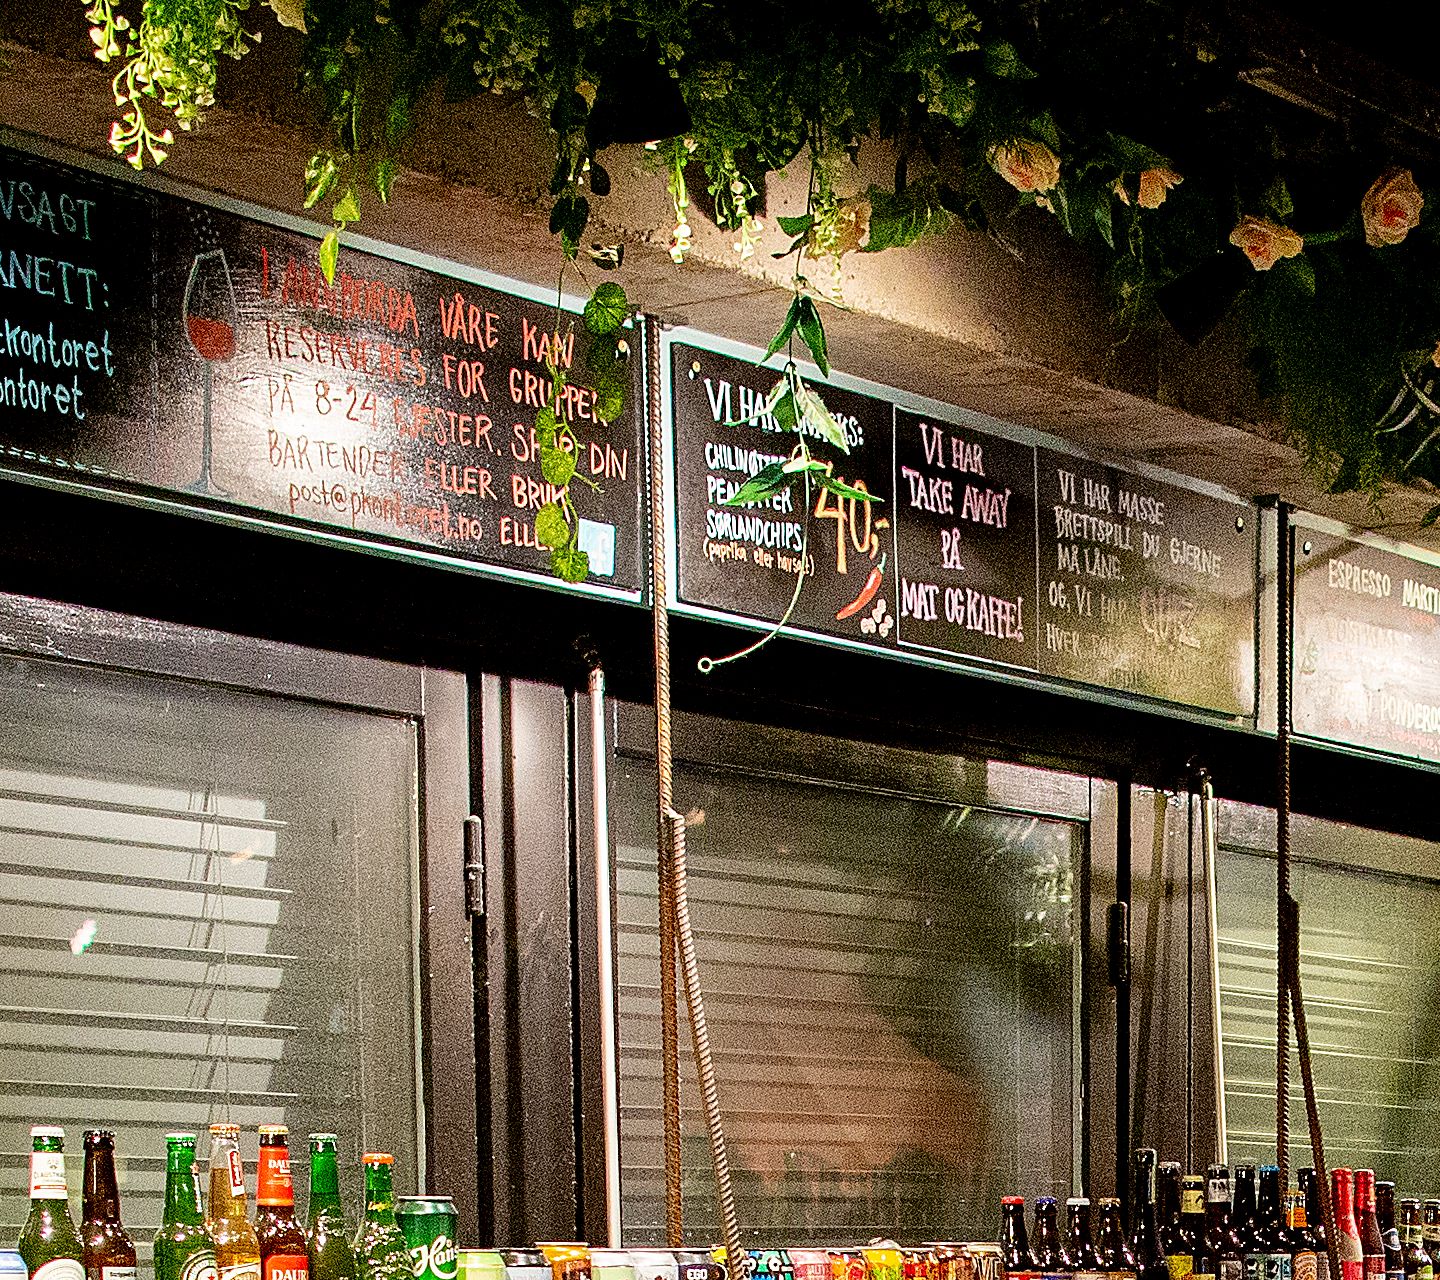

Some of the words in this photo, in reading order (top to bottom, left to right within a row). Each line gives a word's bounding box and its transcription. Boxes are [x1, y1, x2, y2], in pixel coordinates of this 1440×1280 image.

[439, 292, 500, 352] VÅRE
[266, 375, 295, 417] PÅ
[315, 380, 378, 428] 8-24
[920, 423, 943, 466] VI
[951, 436, 984, 471] HAR
[425, 457, 497, 500] ELLER
[901, 466, 953, 515] TAKE
[961, 485, 1012, 529] AWAY
[1059, 469, 1076, 505] VI
[1083, 479, 1113, 512] HAR
[1118, 489, 1164, 526] MASSE
[940, 529, 964, 571] PÅ
[1170, 539, 1223, 579] GJERNE
[1327, 559, 1391, 598] ESPRESSO
[900, 582, 940, 622] MAT
[944, 593, 964, 624] OG
[965, 591, 1024, 643] KAFFE!
[686, 1268, 708, 1280] EGO
